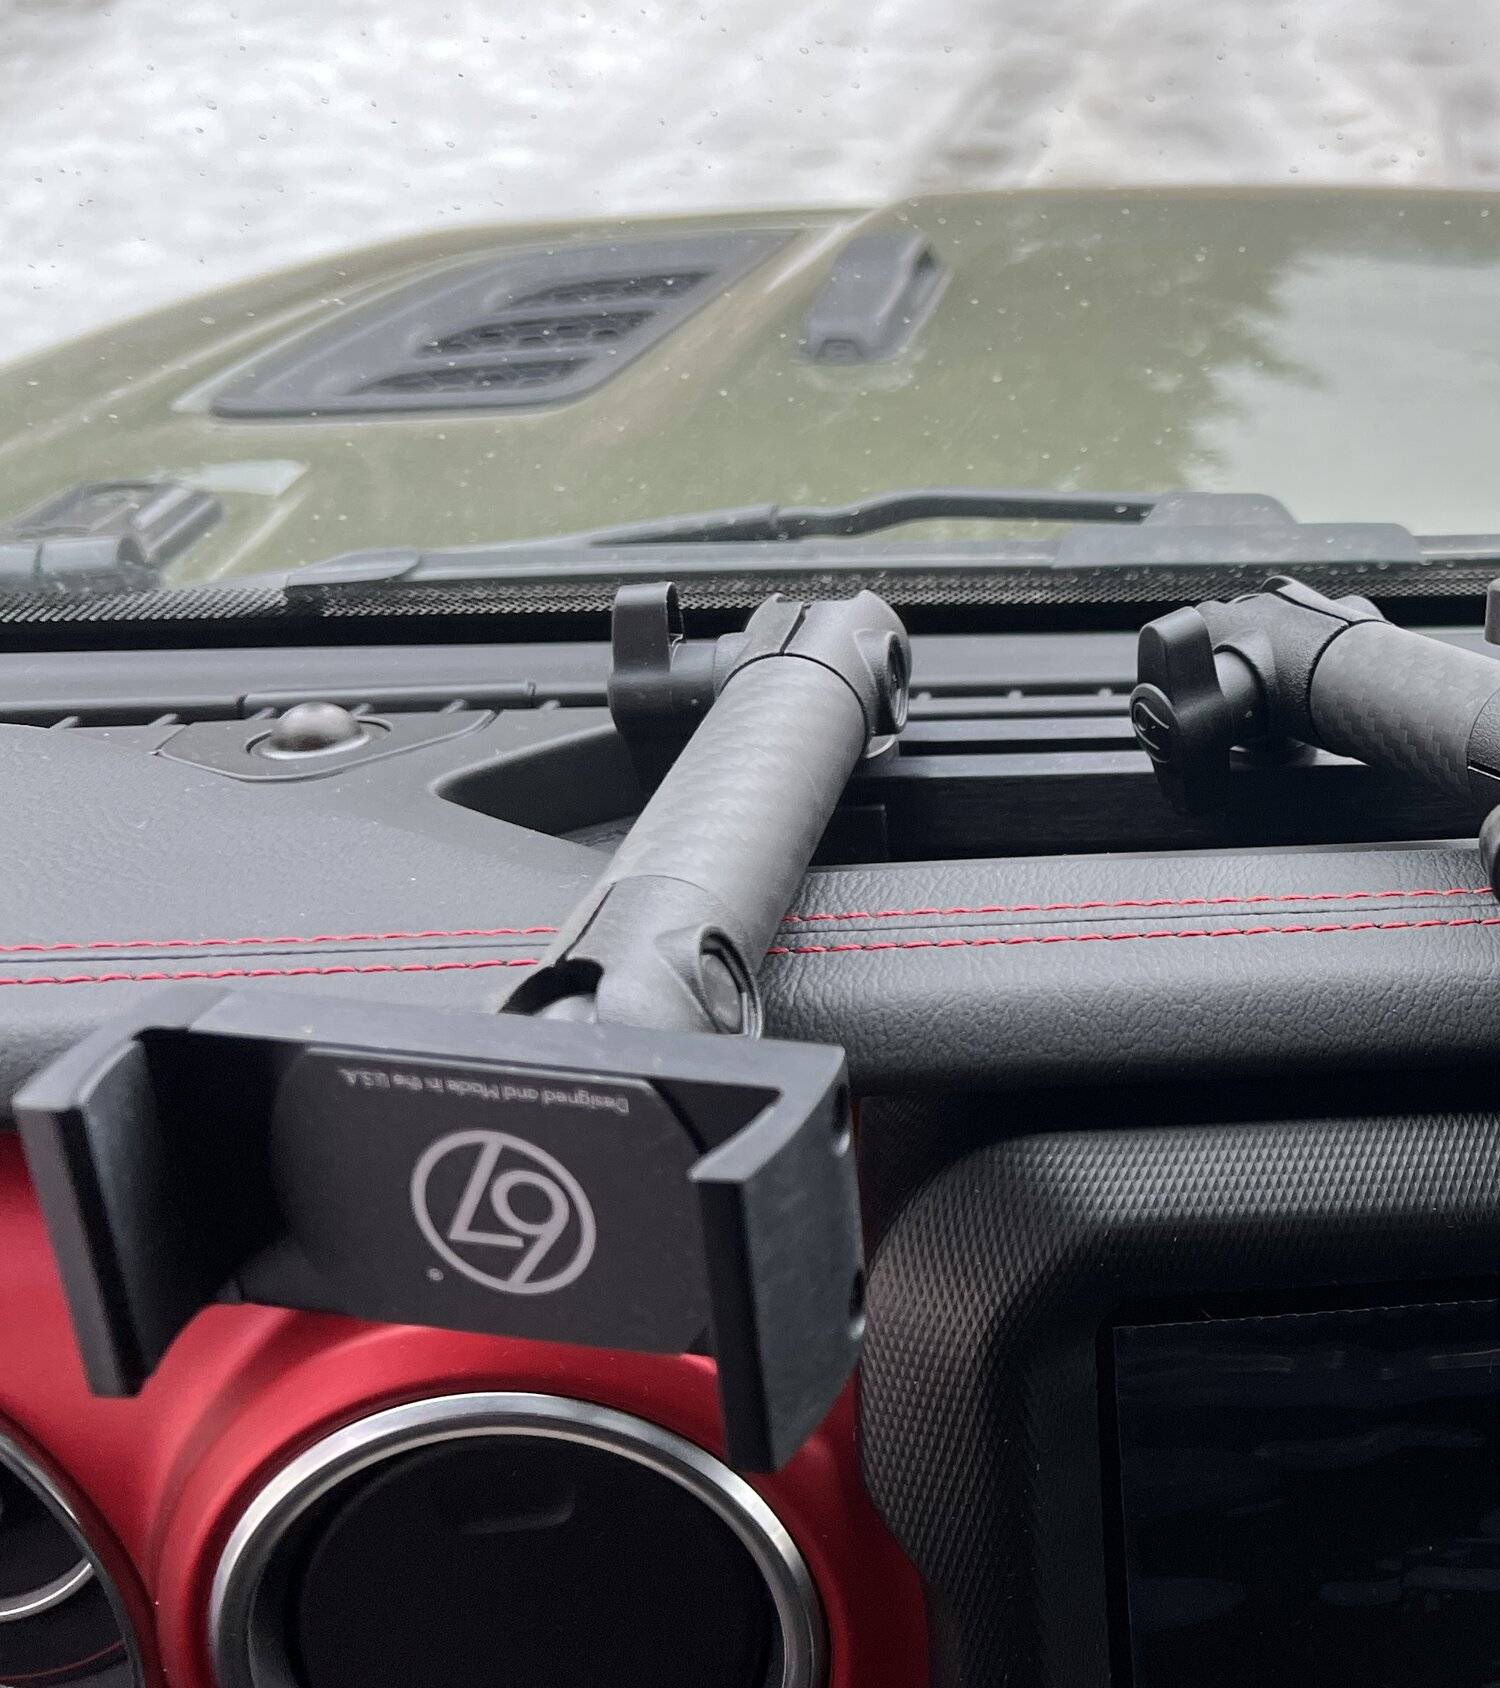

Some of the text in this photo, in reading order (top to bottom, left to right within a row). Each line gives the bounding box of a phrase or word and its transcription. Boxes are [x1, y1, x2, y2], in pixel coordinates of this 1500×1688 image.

[393, 1072, 422, 1091] the
[424, 1076, 443, 1092] in
[446, 1079, 500, 1100] Made
[502, 1085, 540, 1101] and
[541, 1089, 630, 1114] Designed
[449, 1131, 571, 1290] 67
